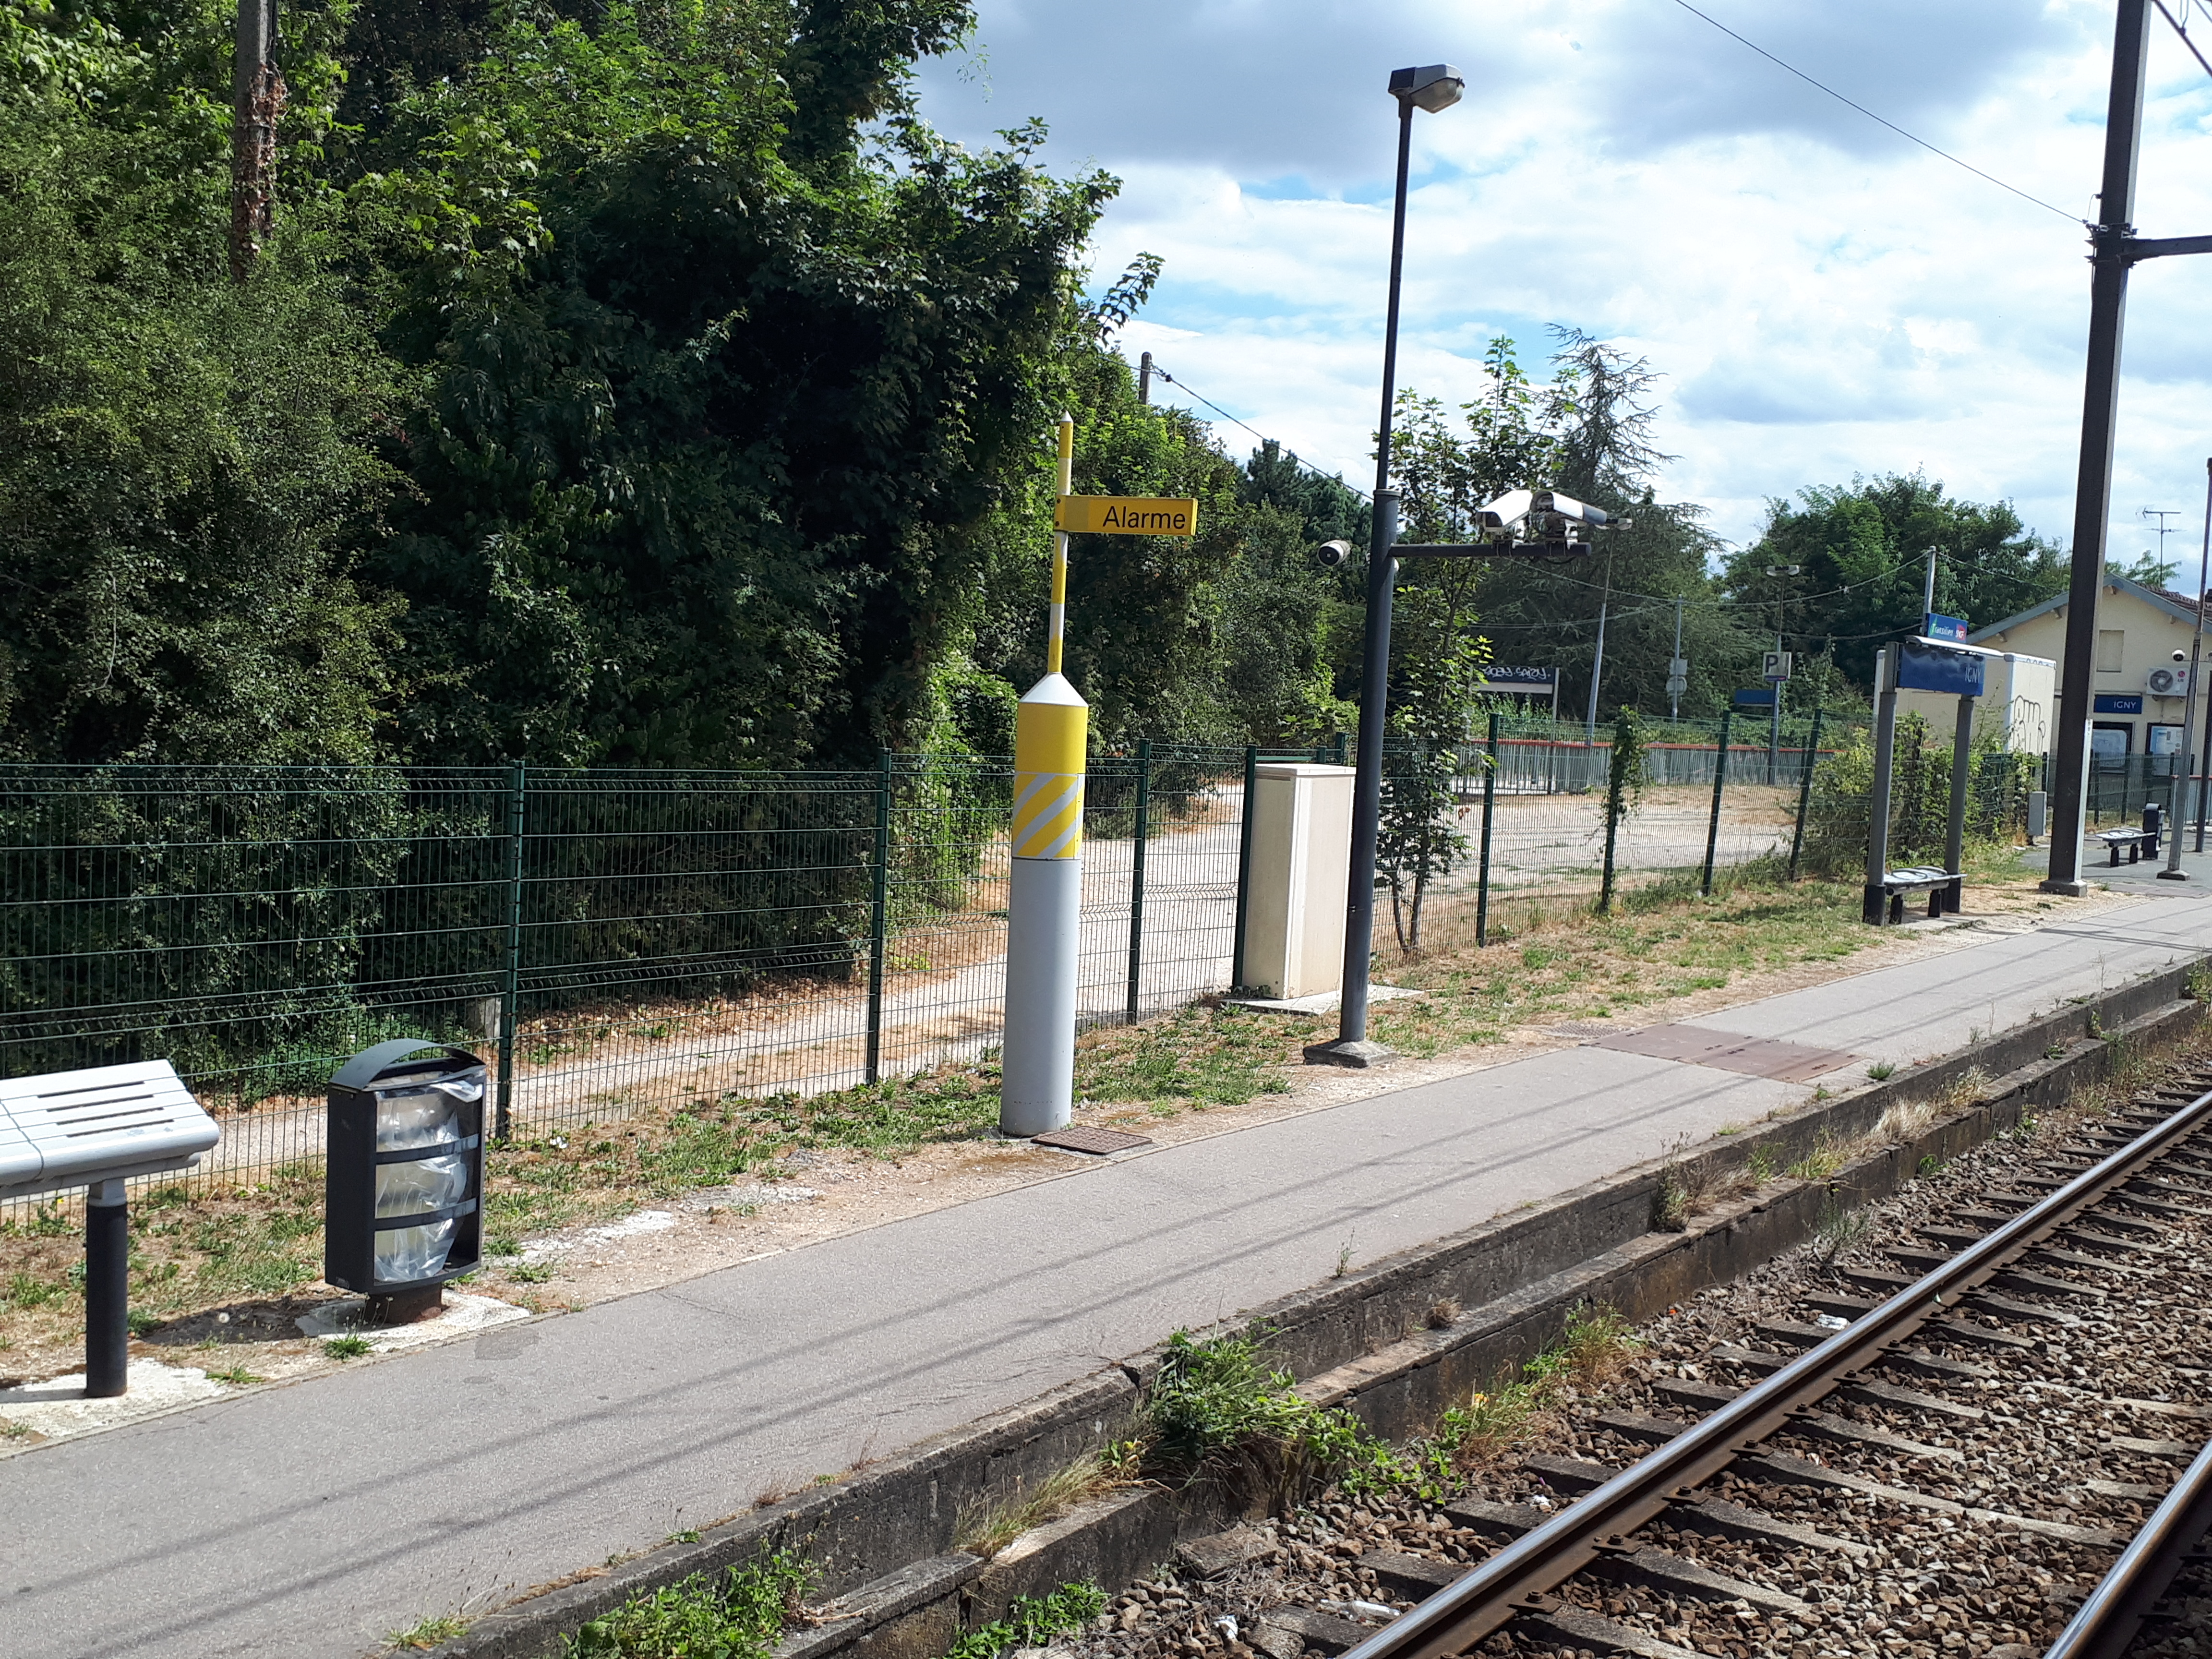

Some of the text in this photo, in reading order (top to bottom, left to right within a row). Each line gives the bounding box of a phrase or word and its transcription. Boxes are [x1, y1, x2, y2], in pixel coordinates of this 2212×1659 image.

[1103, 506, 1185, 529] Alarme
[1765, 655, 1779, 673] P
[1965, 667, 1982, 683] IGNY
